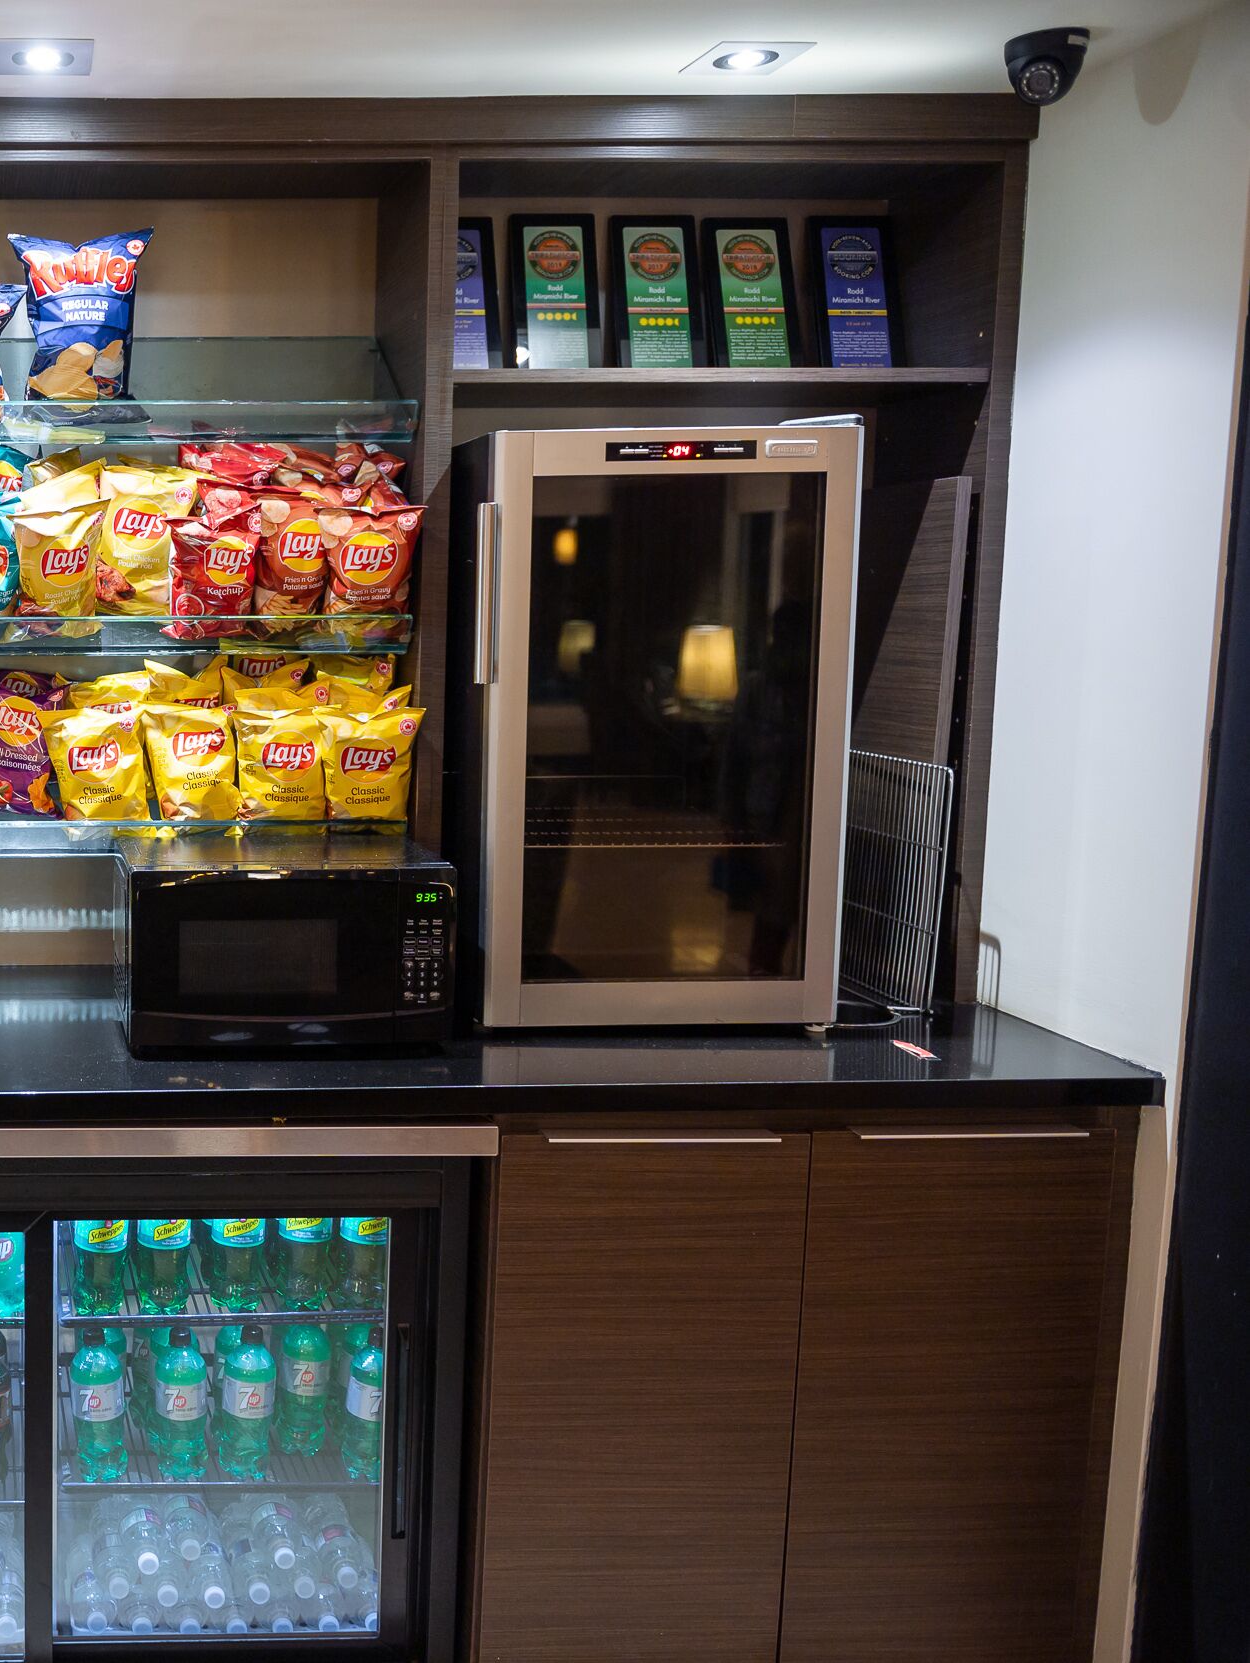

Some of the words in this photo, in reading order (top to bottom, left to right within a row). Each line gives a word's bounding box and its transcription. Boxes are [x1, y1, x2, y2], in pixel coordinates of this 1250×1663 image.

[22, 246, 137, 300] Ruffles
[847, 287, 864, 295] Rodd
[61, 299, 109, 311] REGULAR
[633, 295, 665, 303] Miramichi
[832, 296, 864, 304] Miramichi
[866, 296, 880, 304] River
[65, 312, 105, 321] NATURE
[117, 508, 165, 538] Lay's
[44, 548, 88, 575] Lay's
[207, 547, 252, 575] Lay's
[345, 544, 394, 573] Lay's
[207, 586, 244, 600] Ketchup
[244, 656, 286, 677] Lay's
[178, 729, 224, 757] Lay's
[70, 740, 117, 772] Lay's
[268, 742, 312, 770] Lay's
[345, 747, 394, 771] Lay's
[186, 769, 219, 781] Classic
[83, 785, 115, 795] Classic
[271, 784, 305, 794] Classic
[351, 786, 385, 796] Classic
[79, 794, 122, 805] Classique
[265, 793, 310, 803] Classique
[345, 795, 391, 805] Classique
[90, 1223, 124, 1242] Schweppes
[156, 1219, 188, 1239] Schweppes
[225, 1219, 259, 1236] Schweppes
